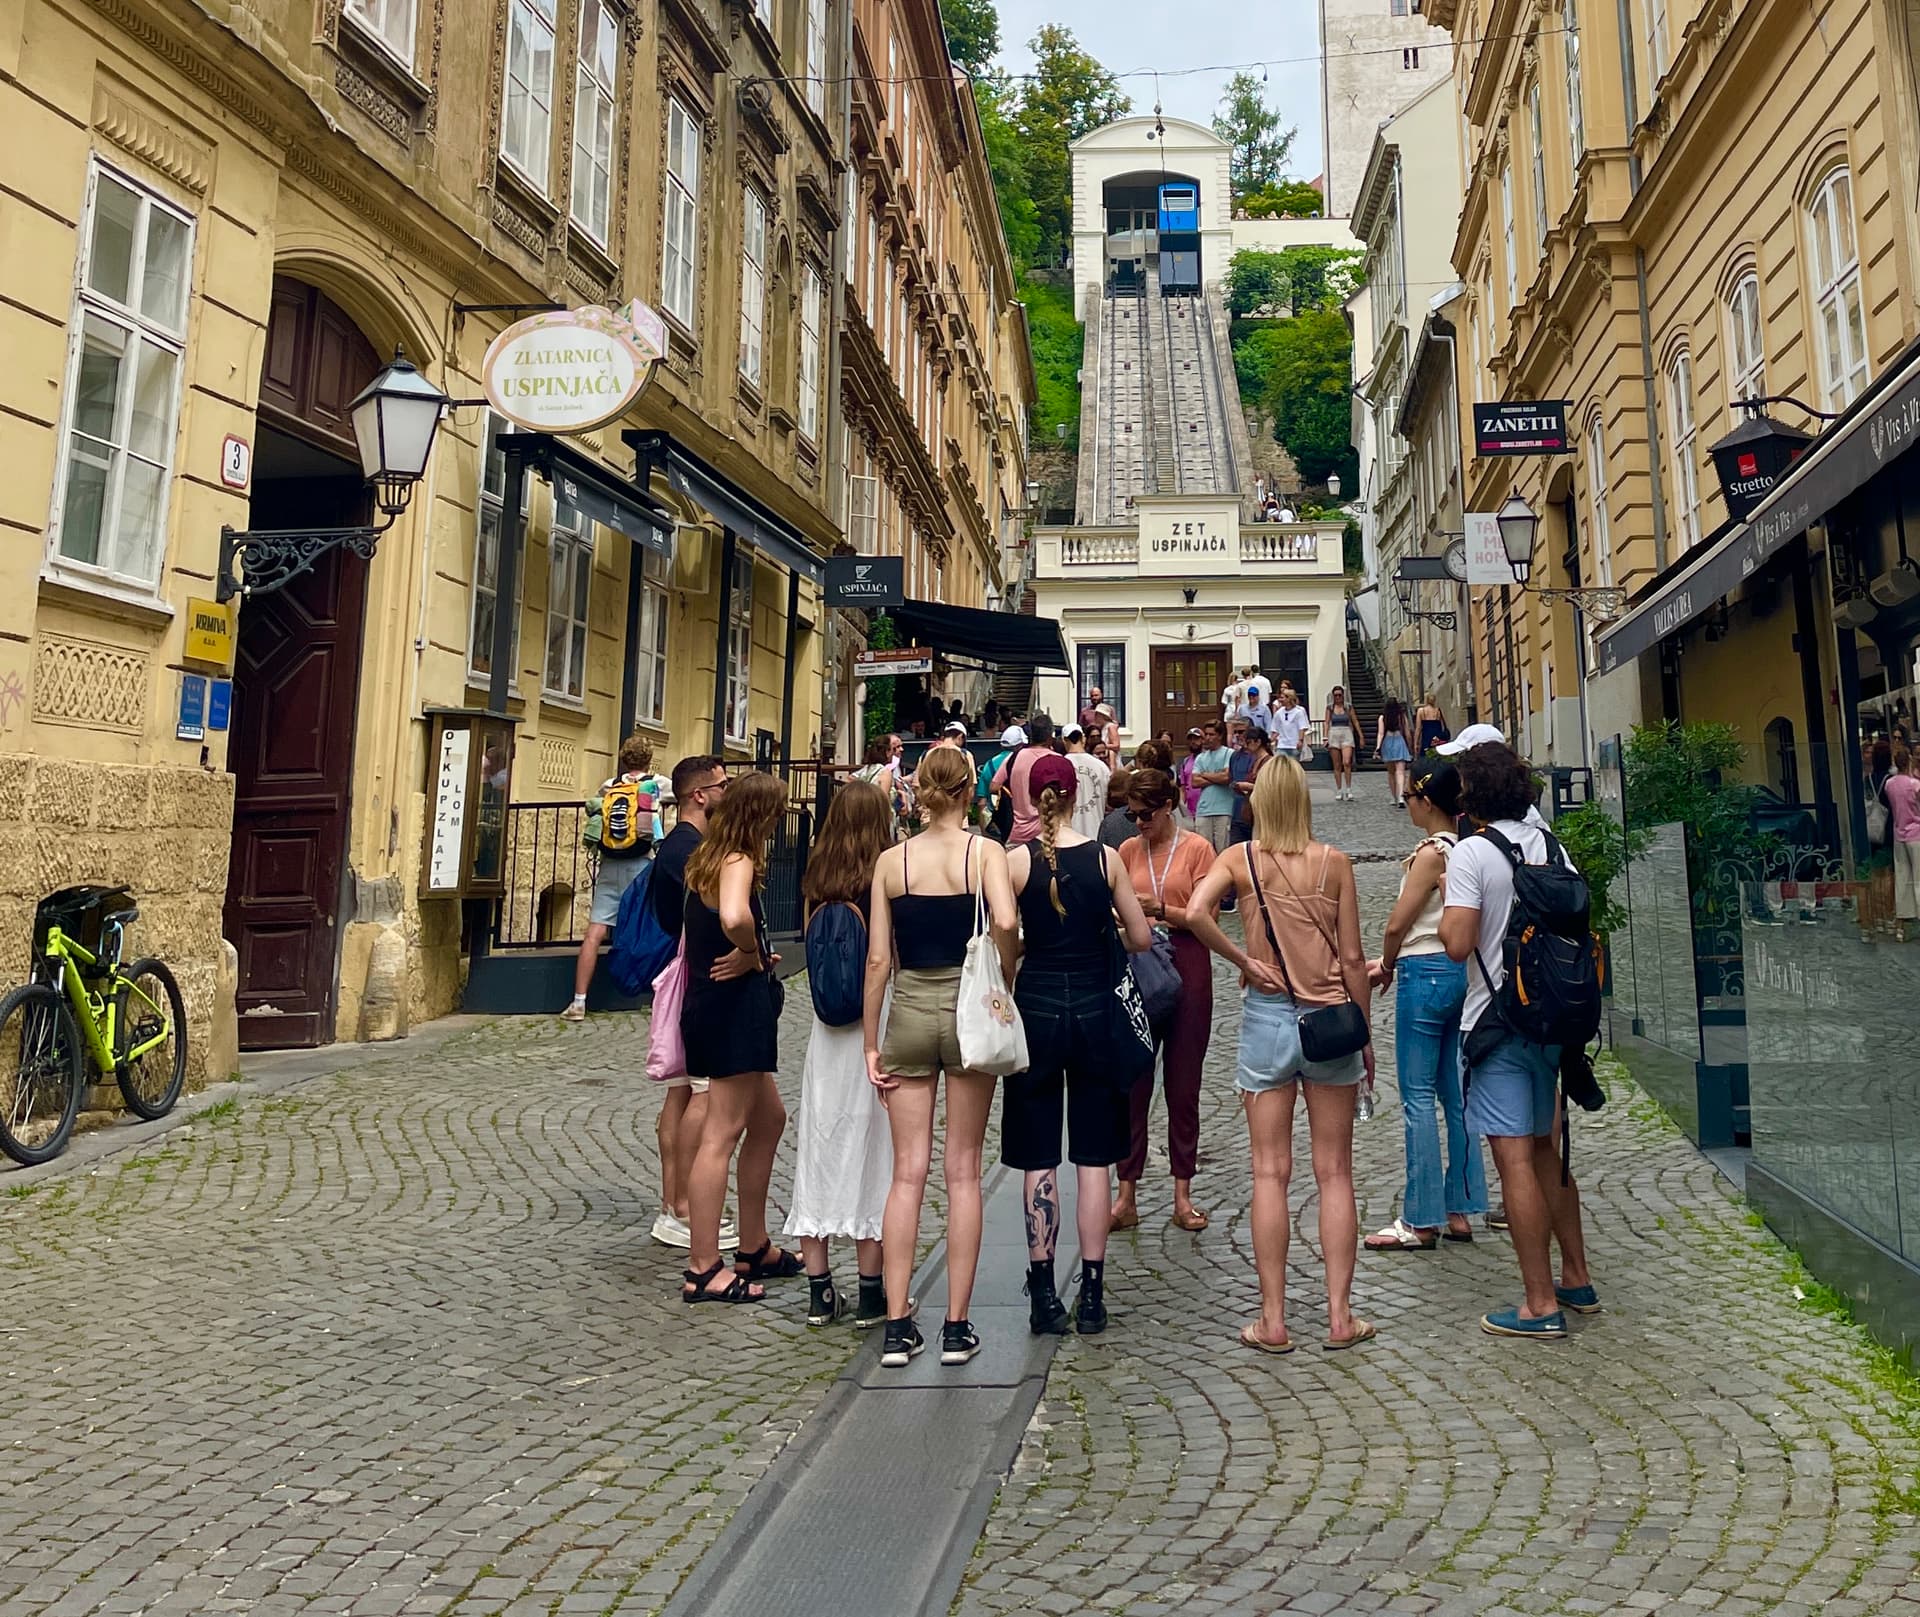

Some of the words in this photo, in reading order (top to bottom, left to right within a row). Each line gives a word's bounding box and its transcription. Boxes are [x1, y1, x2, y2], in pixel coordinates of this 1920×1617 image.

[514, 348, 613, 366] ZLATARNICA
[503, 369, 622, 398] USPINJAČA
[1909, 396, 1920, 426] VI
[1481, 415, 1558, 433] ZANETTI
[233, 443, 241, 470] 3
[1729, 475, 1774, 496] Stretto
[1172, 522, 1205, 535] ZET
[1474, 521, 1499, 535] TA
[1152, 535, 1226, 552] USPINJAČA
[1475, 552, 1507, 564] HOM
[838, 582, 888, 594] USPINJAČA
[195, 613, 226, 635] KRMIVA
[451, 784, 461, 827] LOM
